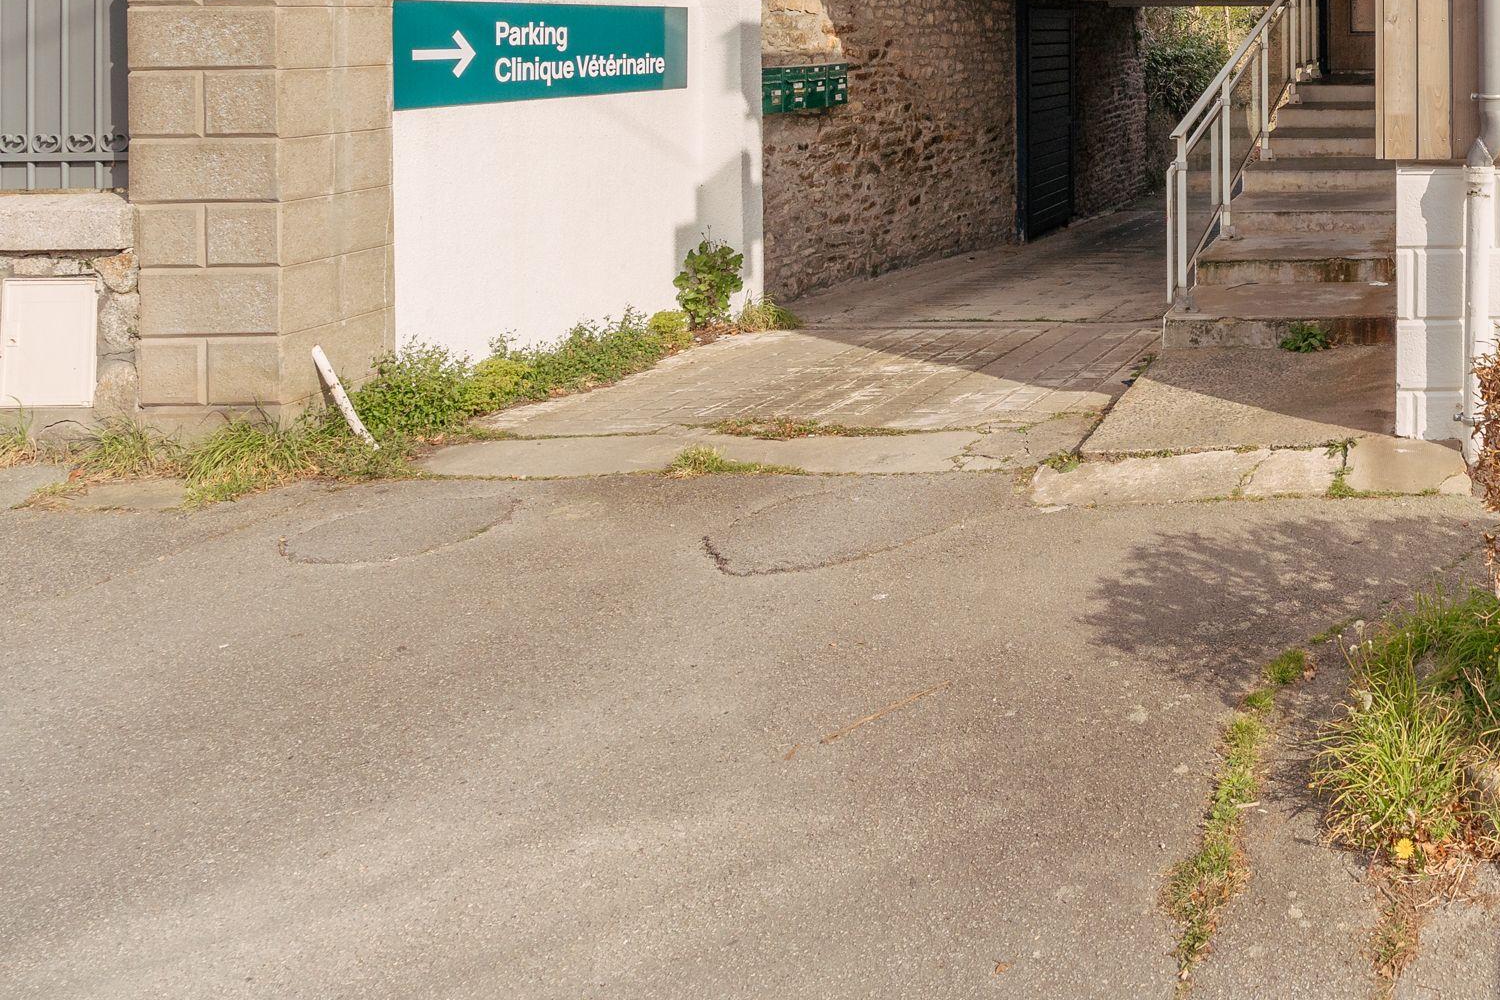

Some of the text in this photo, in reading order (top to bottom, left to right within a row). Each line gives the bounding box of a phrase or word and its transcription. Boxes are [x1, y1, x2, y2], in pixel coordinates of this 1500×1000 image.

[494, 21, 568, 52] Parking
[494, 53, 665, 87] Clinique Vétérinaire
